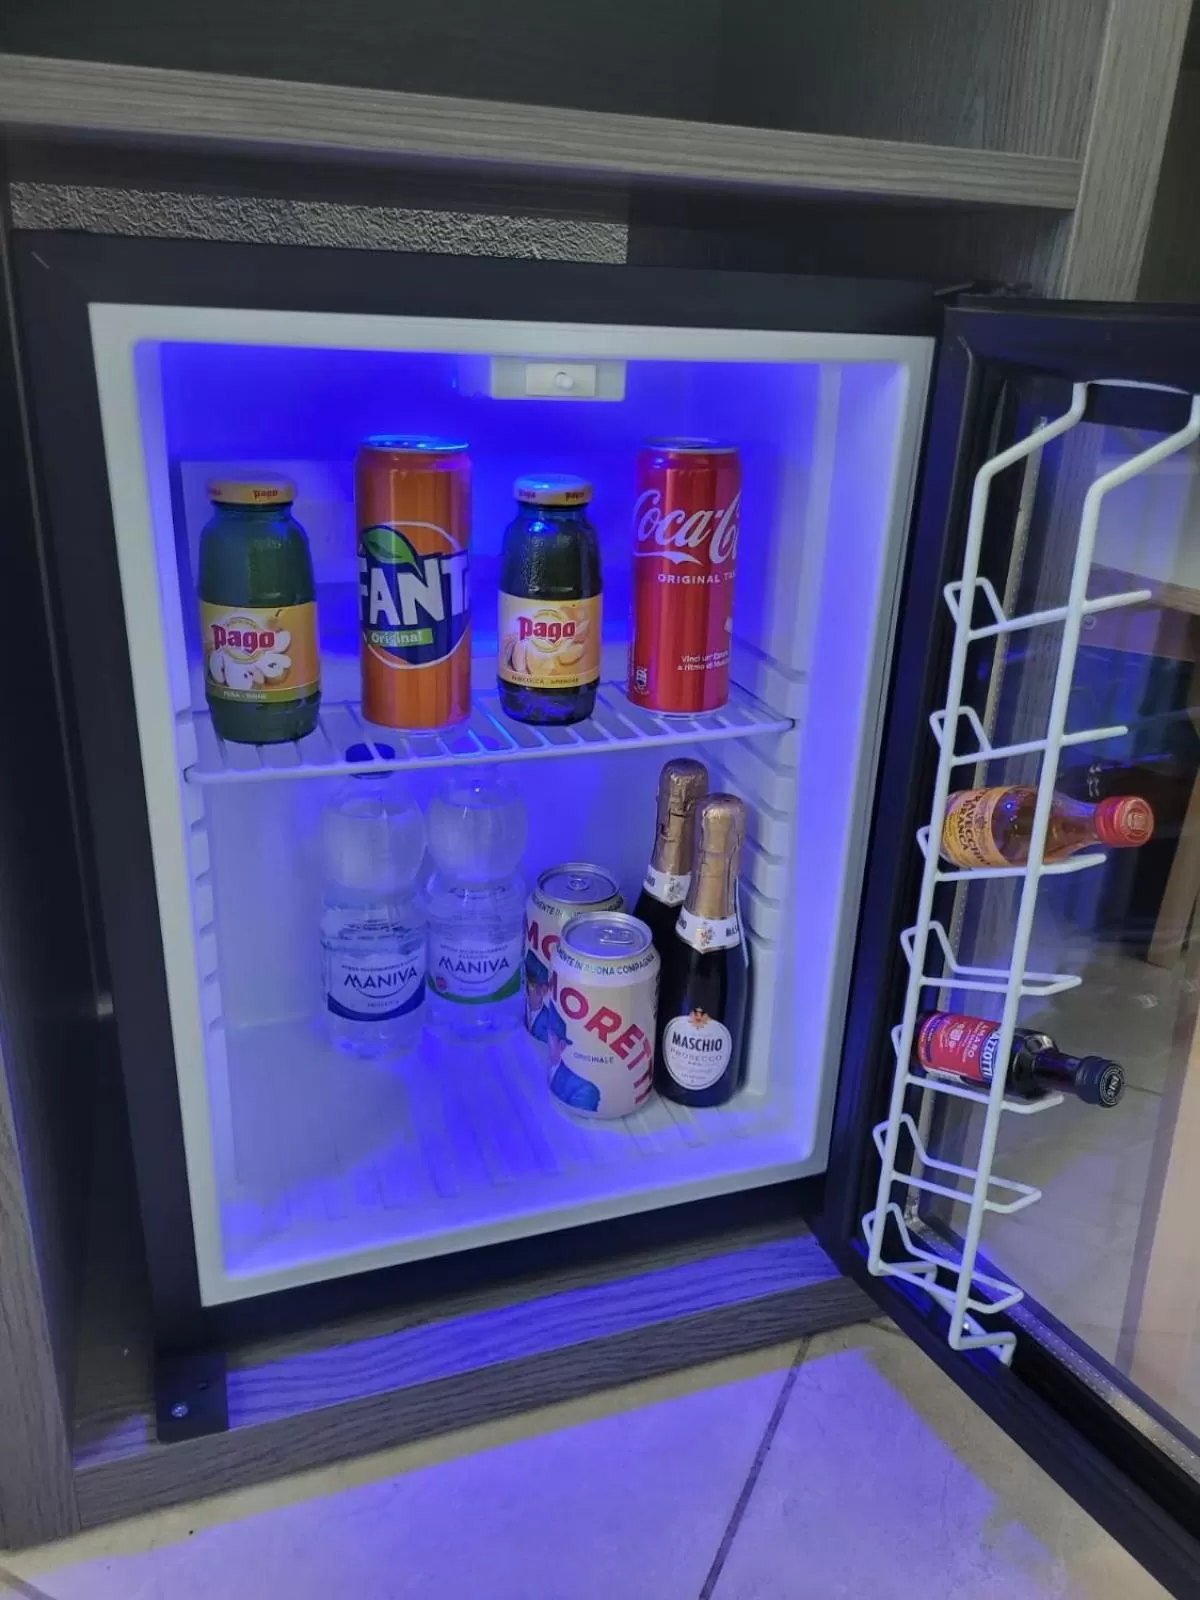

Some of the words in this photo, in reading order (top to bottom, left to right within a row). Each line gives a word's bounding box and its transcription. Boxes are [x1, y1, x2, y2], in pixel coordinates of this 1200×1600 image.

[357, 554, 470, 626] FANT
[657, 573, 720, 585] ORIGINAL
[210, 623, 275, 654] pago
[371, 631, 423, 646] Original
[516, 615, 576, 645] pago
[438, 955, 510, 975] MANIVA
[343, 965, 418, 990] MANIVA
[671, 1031, 723, 1053] MASCHIO
